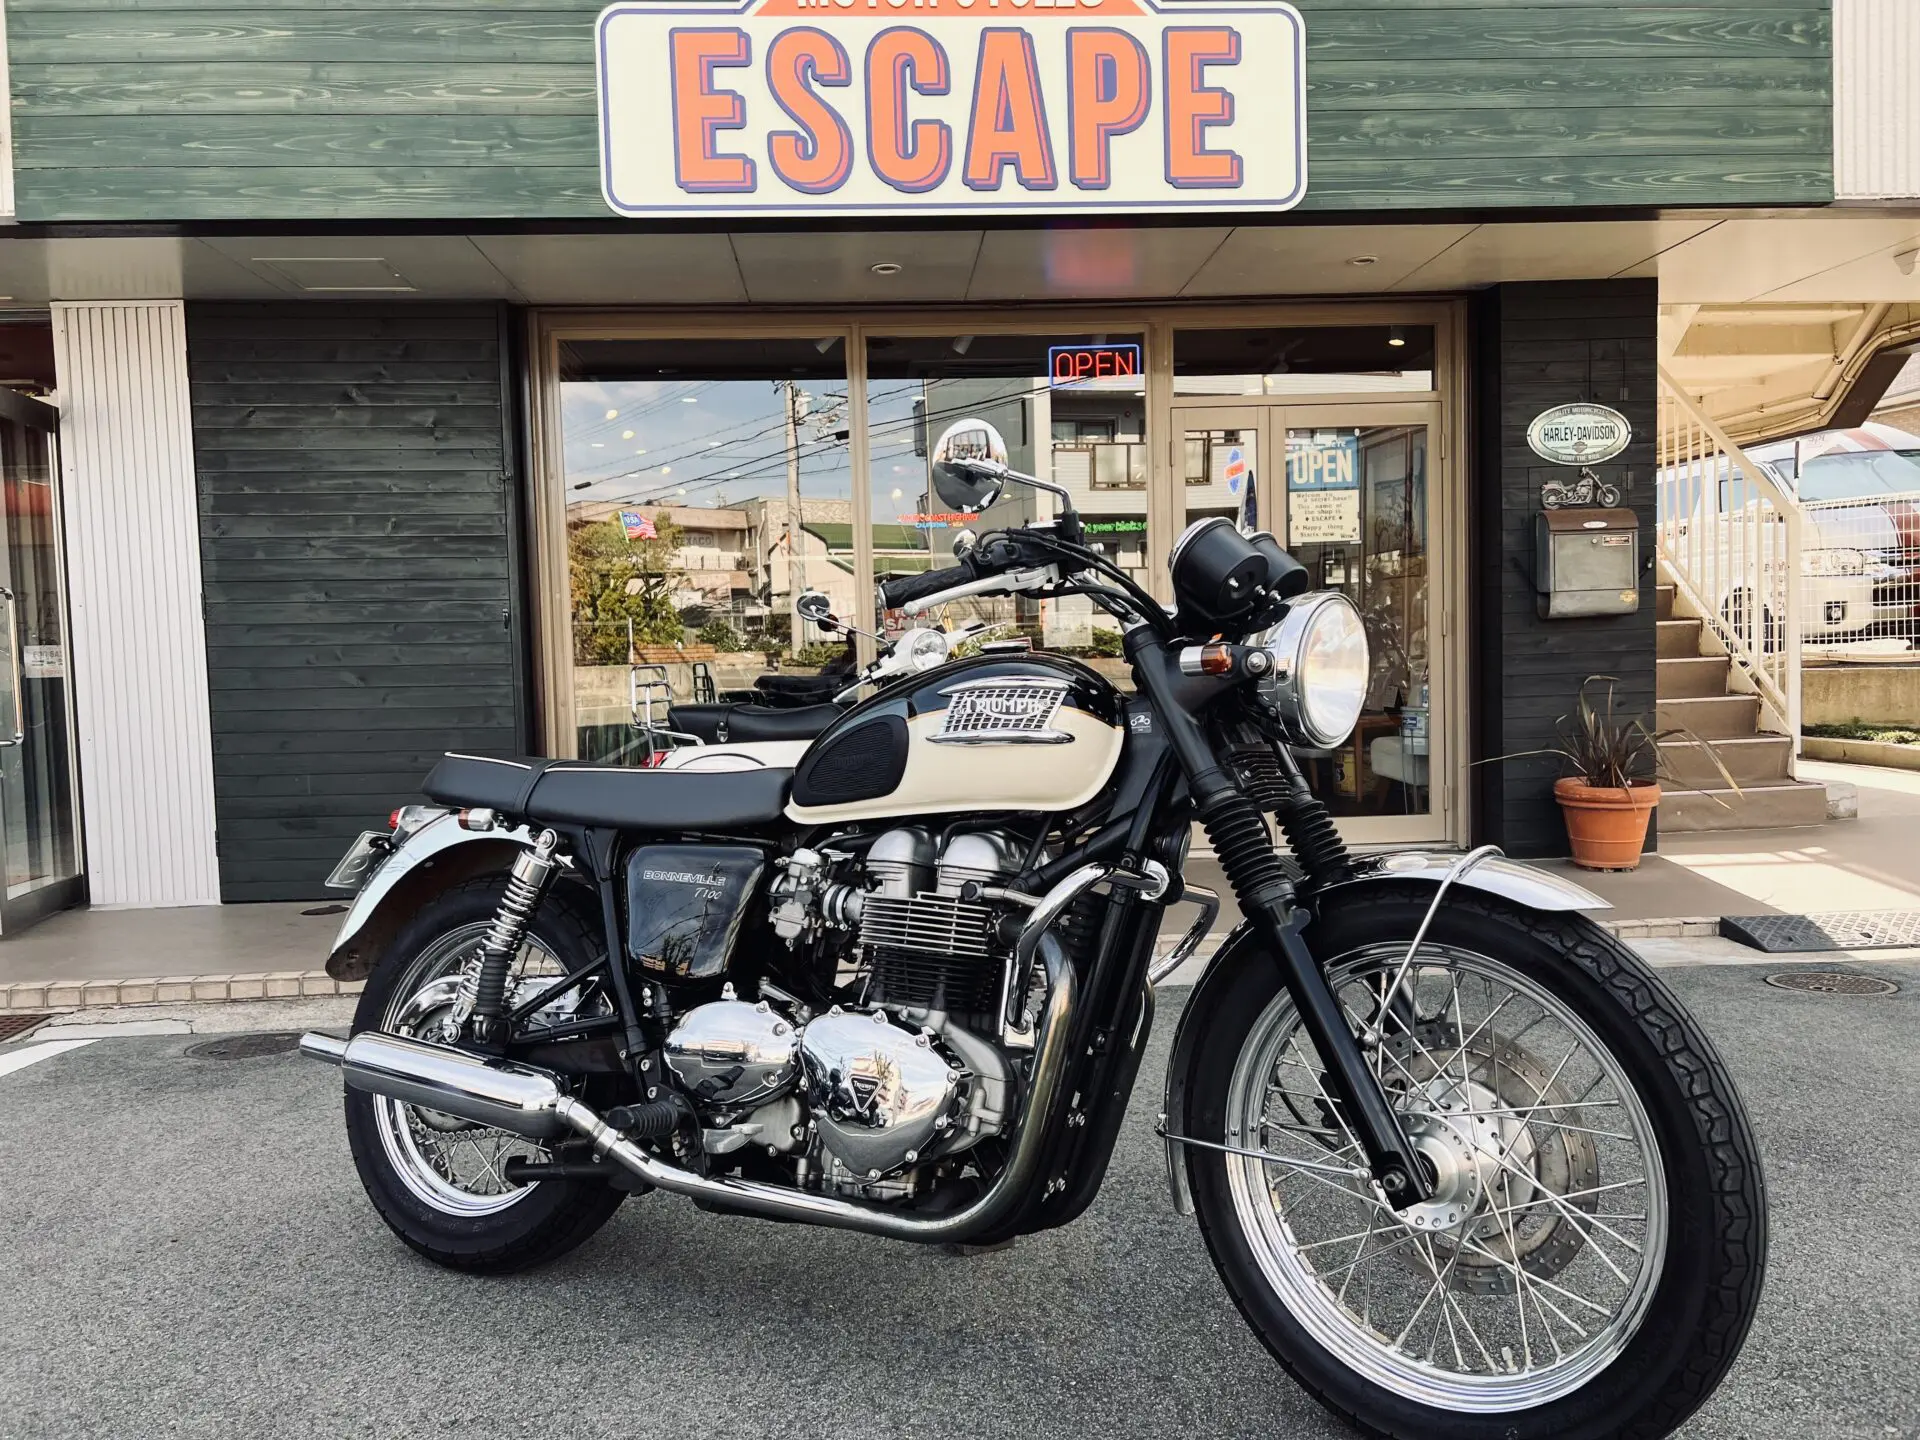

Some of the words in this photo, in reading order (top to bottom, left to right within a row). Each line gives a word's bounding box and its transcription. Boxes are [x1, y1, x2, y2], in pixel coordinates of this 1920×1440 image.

[670, 26, 1244, 194] ESCAPE
[1056, 351, 1133, 381] OPEN
[1543, 425, 1616, 442] HARLEY-DAVIDSON
[1293, 449, 1353, 484] OPEN
[965, 698, 1040, 719] TRIUMPH
[643, 870, 727, 887] BONNEVILLE
[694, 886, 723, 900] T100
